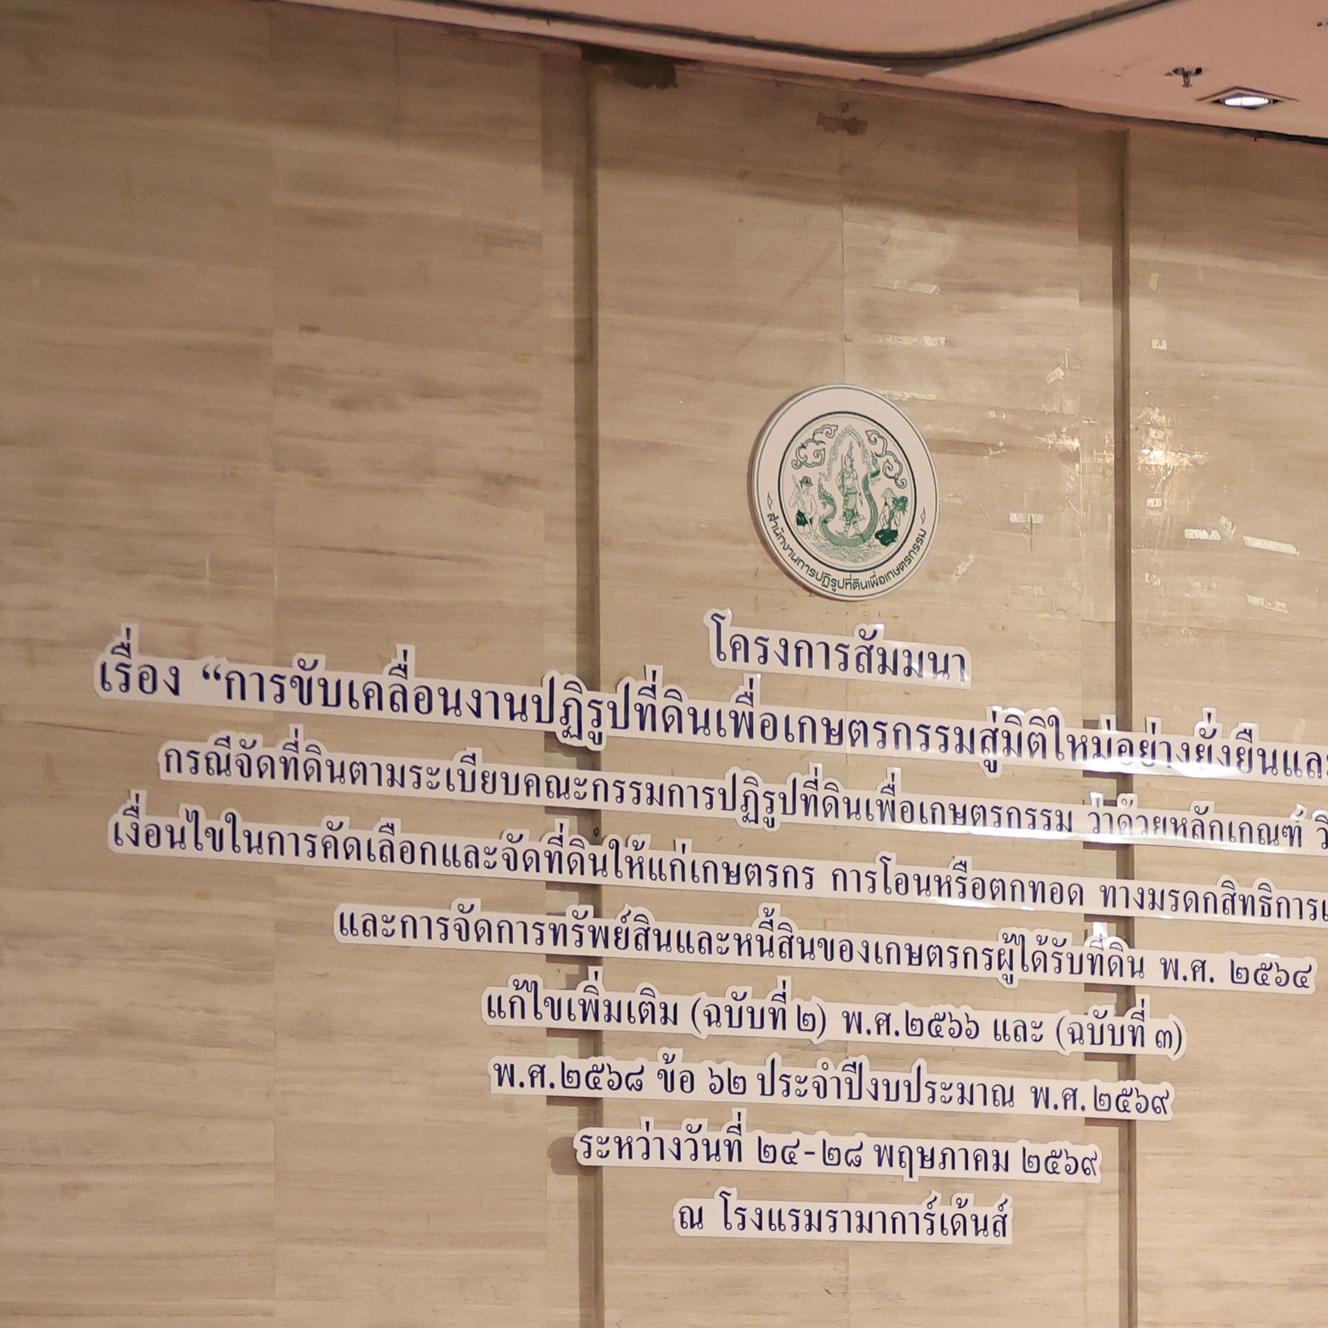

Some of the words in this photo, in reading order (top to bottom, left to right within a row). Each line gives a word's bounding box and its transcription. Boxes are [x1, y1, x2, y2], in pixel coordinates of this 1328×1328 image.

[766, 512, 928, 592] สำนักงานการปฏิรูปที่ดินเพื่อเกษตรกรรม
[100, 628, 181, 697] เรื่อง
[710, 613, 967, 683] โครงการสัมมนา
[163, 729, 1073, 833] กรณีจัดที่ดินตามระเบียบคณะกรรมการปฏิรูปที่ดินเพื่อเกษตรกรรม
[1088, 794, 1303, 849] ว่าด้วยหลักเกณฑ์
[114, 794, 815, 890] เงื่อนไขในการคัดเลือกและจัดที่ดินให้แก่เกษตรกร
[832, 857, 1084, 908] การโอนหรือตกทอด
[339, 903, 1145, 984] และการจัดการทรัพย์สินและหนี้สินของเกษตรกรผู้ได้รับที่ดิน
[1160, 957, 1215, 984] พ.ศ.
[1230, 959, 1313, 989] ๒๕๖๔
[487, 971, 679, 1027] แก้ไขเพิ่มเติม
[842, 1007, 980, 1039] พ.ศ.๒๕๖๖
[993, 1014, 1043, 1043] และ
[494, 1060, 643, 1092] พ.ศ.๒๕๖๘
[657, 1053, 695, 1093] ข้อ
[709, 1066, 747, 1095] ๖๒
[758, 1058, 1015, 1108] ประจำปีงบประมาณ
[1031, 1083, 1170, 1115] พ.ศ.๒๕๖๙
[580, 1113, 742, 1164] ระหว่างวันที่
[757, 1134, 864, 1168] ๒๔-๒๘
[874, 1142, 1009, 1178] พฤษภาคม
[1022, 1144, 1098, 1177] ๒๕๖๙
[678, 1203, 703, 1231] ณ
[719, 1191, 1008, 1238] โรงแรมรามาการ์เด้นส์
